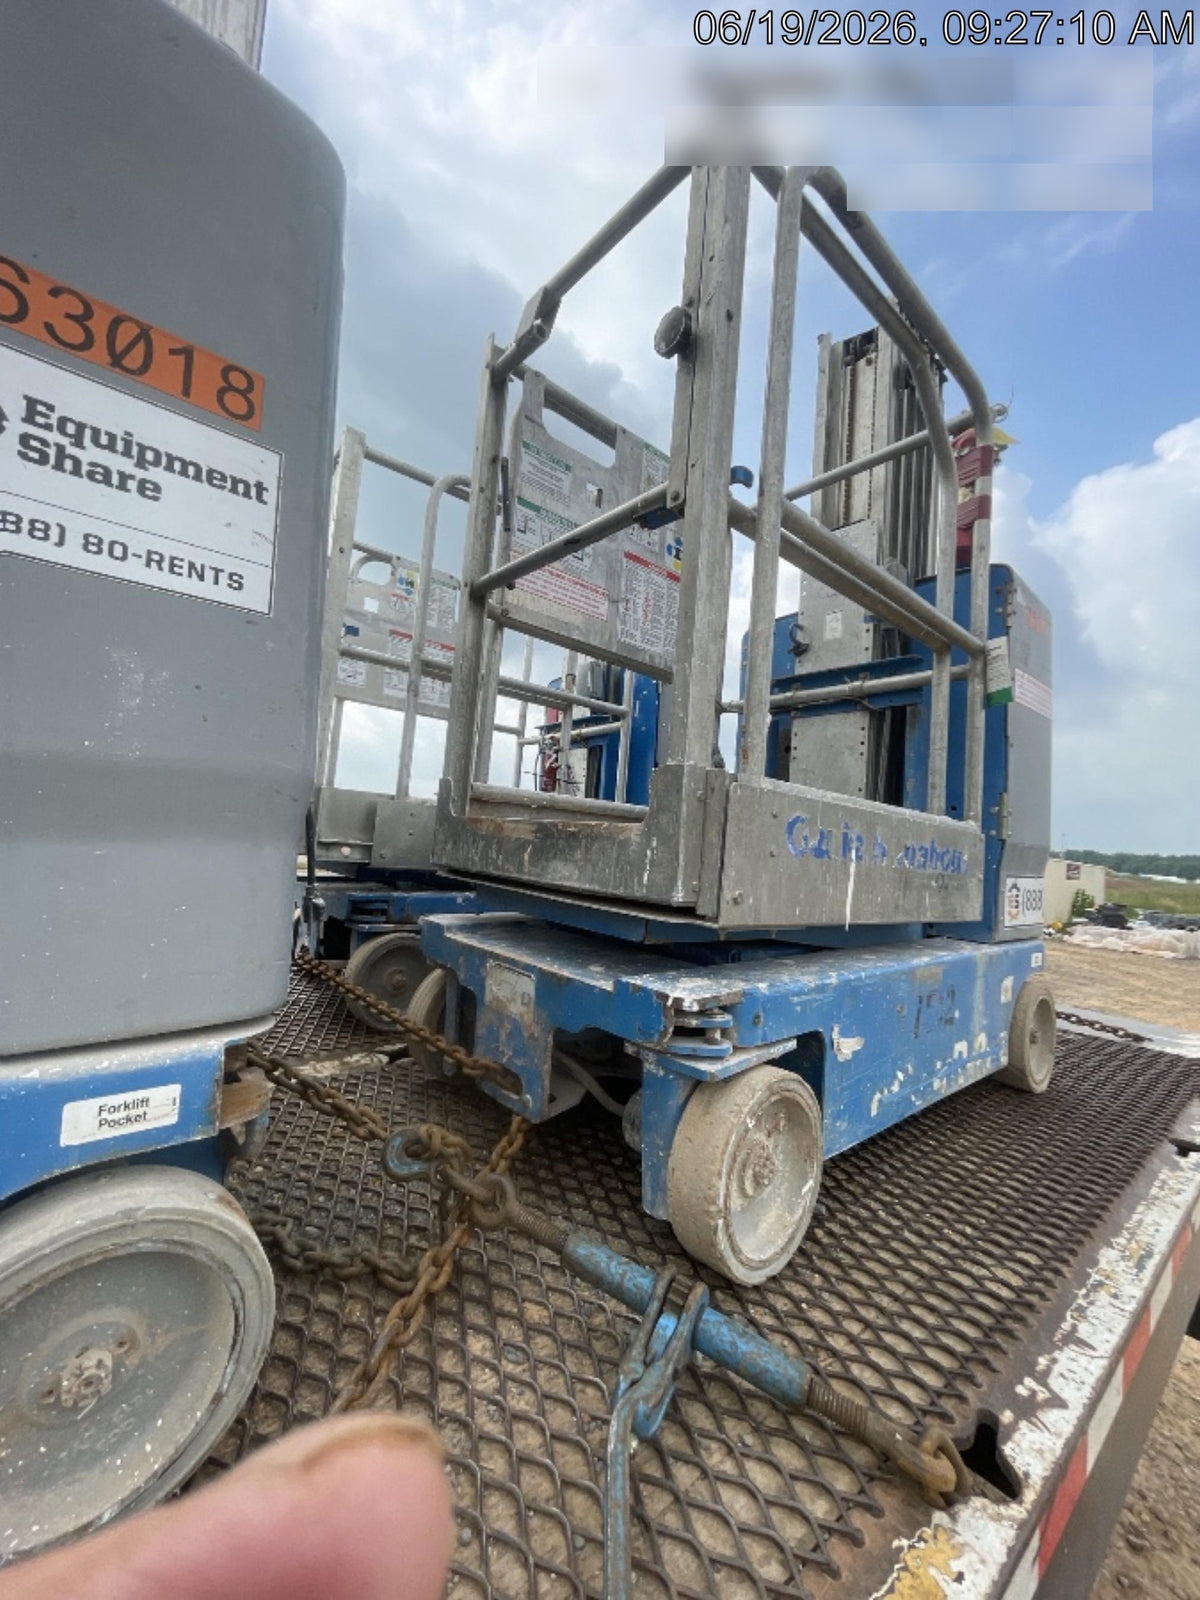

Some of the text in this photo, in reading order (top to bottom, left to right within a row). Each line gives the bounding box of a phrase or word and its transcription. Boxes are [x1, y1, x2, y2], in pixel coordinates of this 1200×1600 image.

[17, 431, 163, 502] Share
[20, 394, 270, 505] Equipment
[82, 532, 245, 592] 80-RENTS
[98, 1096, 150, 1117] Forklift
[98, 1111, 148, 1130] Pocket
